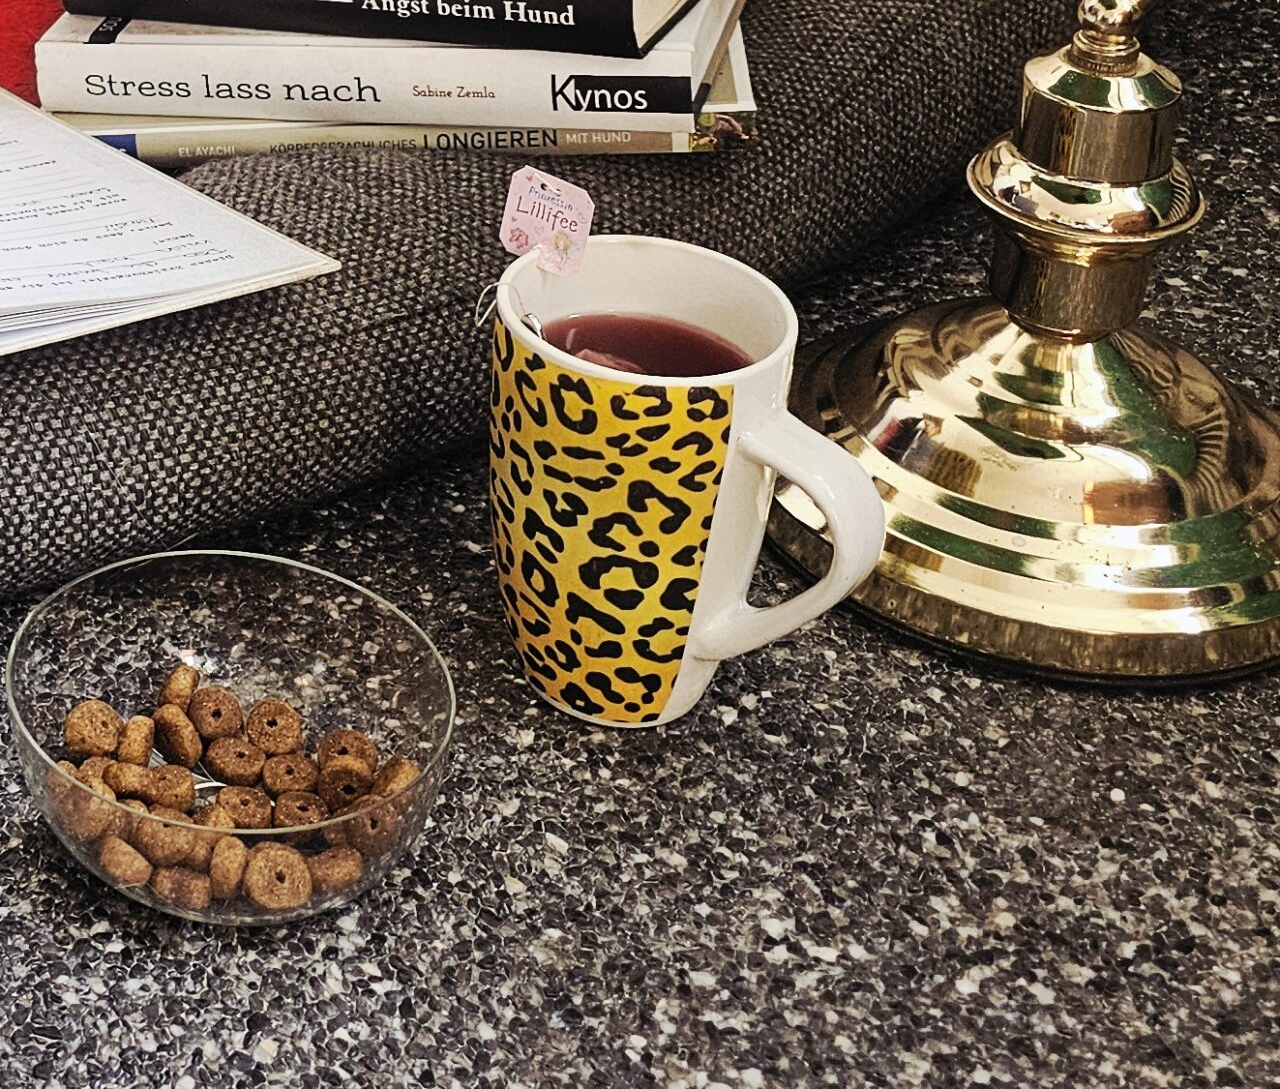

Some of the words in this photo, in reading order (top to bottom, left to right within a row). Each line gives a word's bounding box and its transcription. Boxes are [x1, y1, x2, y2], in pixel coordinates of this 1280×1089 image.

[503, 0, 576, 26] Hund
[85, 74, 191, 98] Stress
[202, 74, 271, 99] lass
[283, 77, 381, 102] nach
[412, 85, 453, 98] Sabine
[456, 86, 496, 98] Zemla
[551, 74, 648, 112] Kynos
[194, 145, 236, 157] AYACHI
[423, 129, 559, 151] LONGIEREN
[566, 133, 589, 144] MIT
[592, 131, 631, 143] HUND
[516, 194, 579, 233] Lillifee
